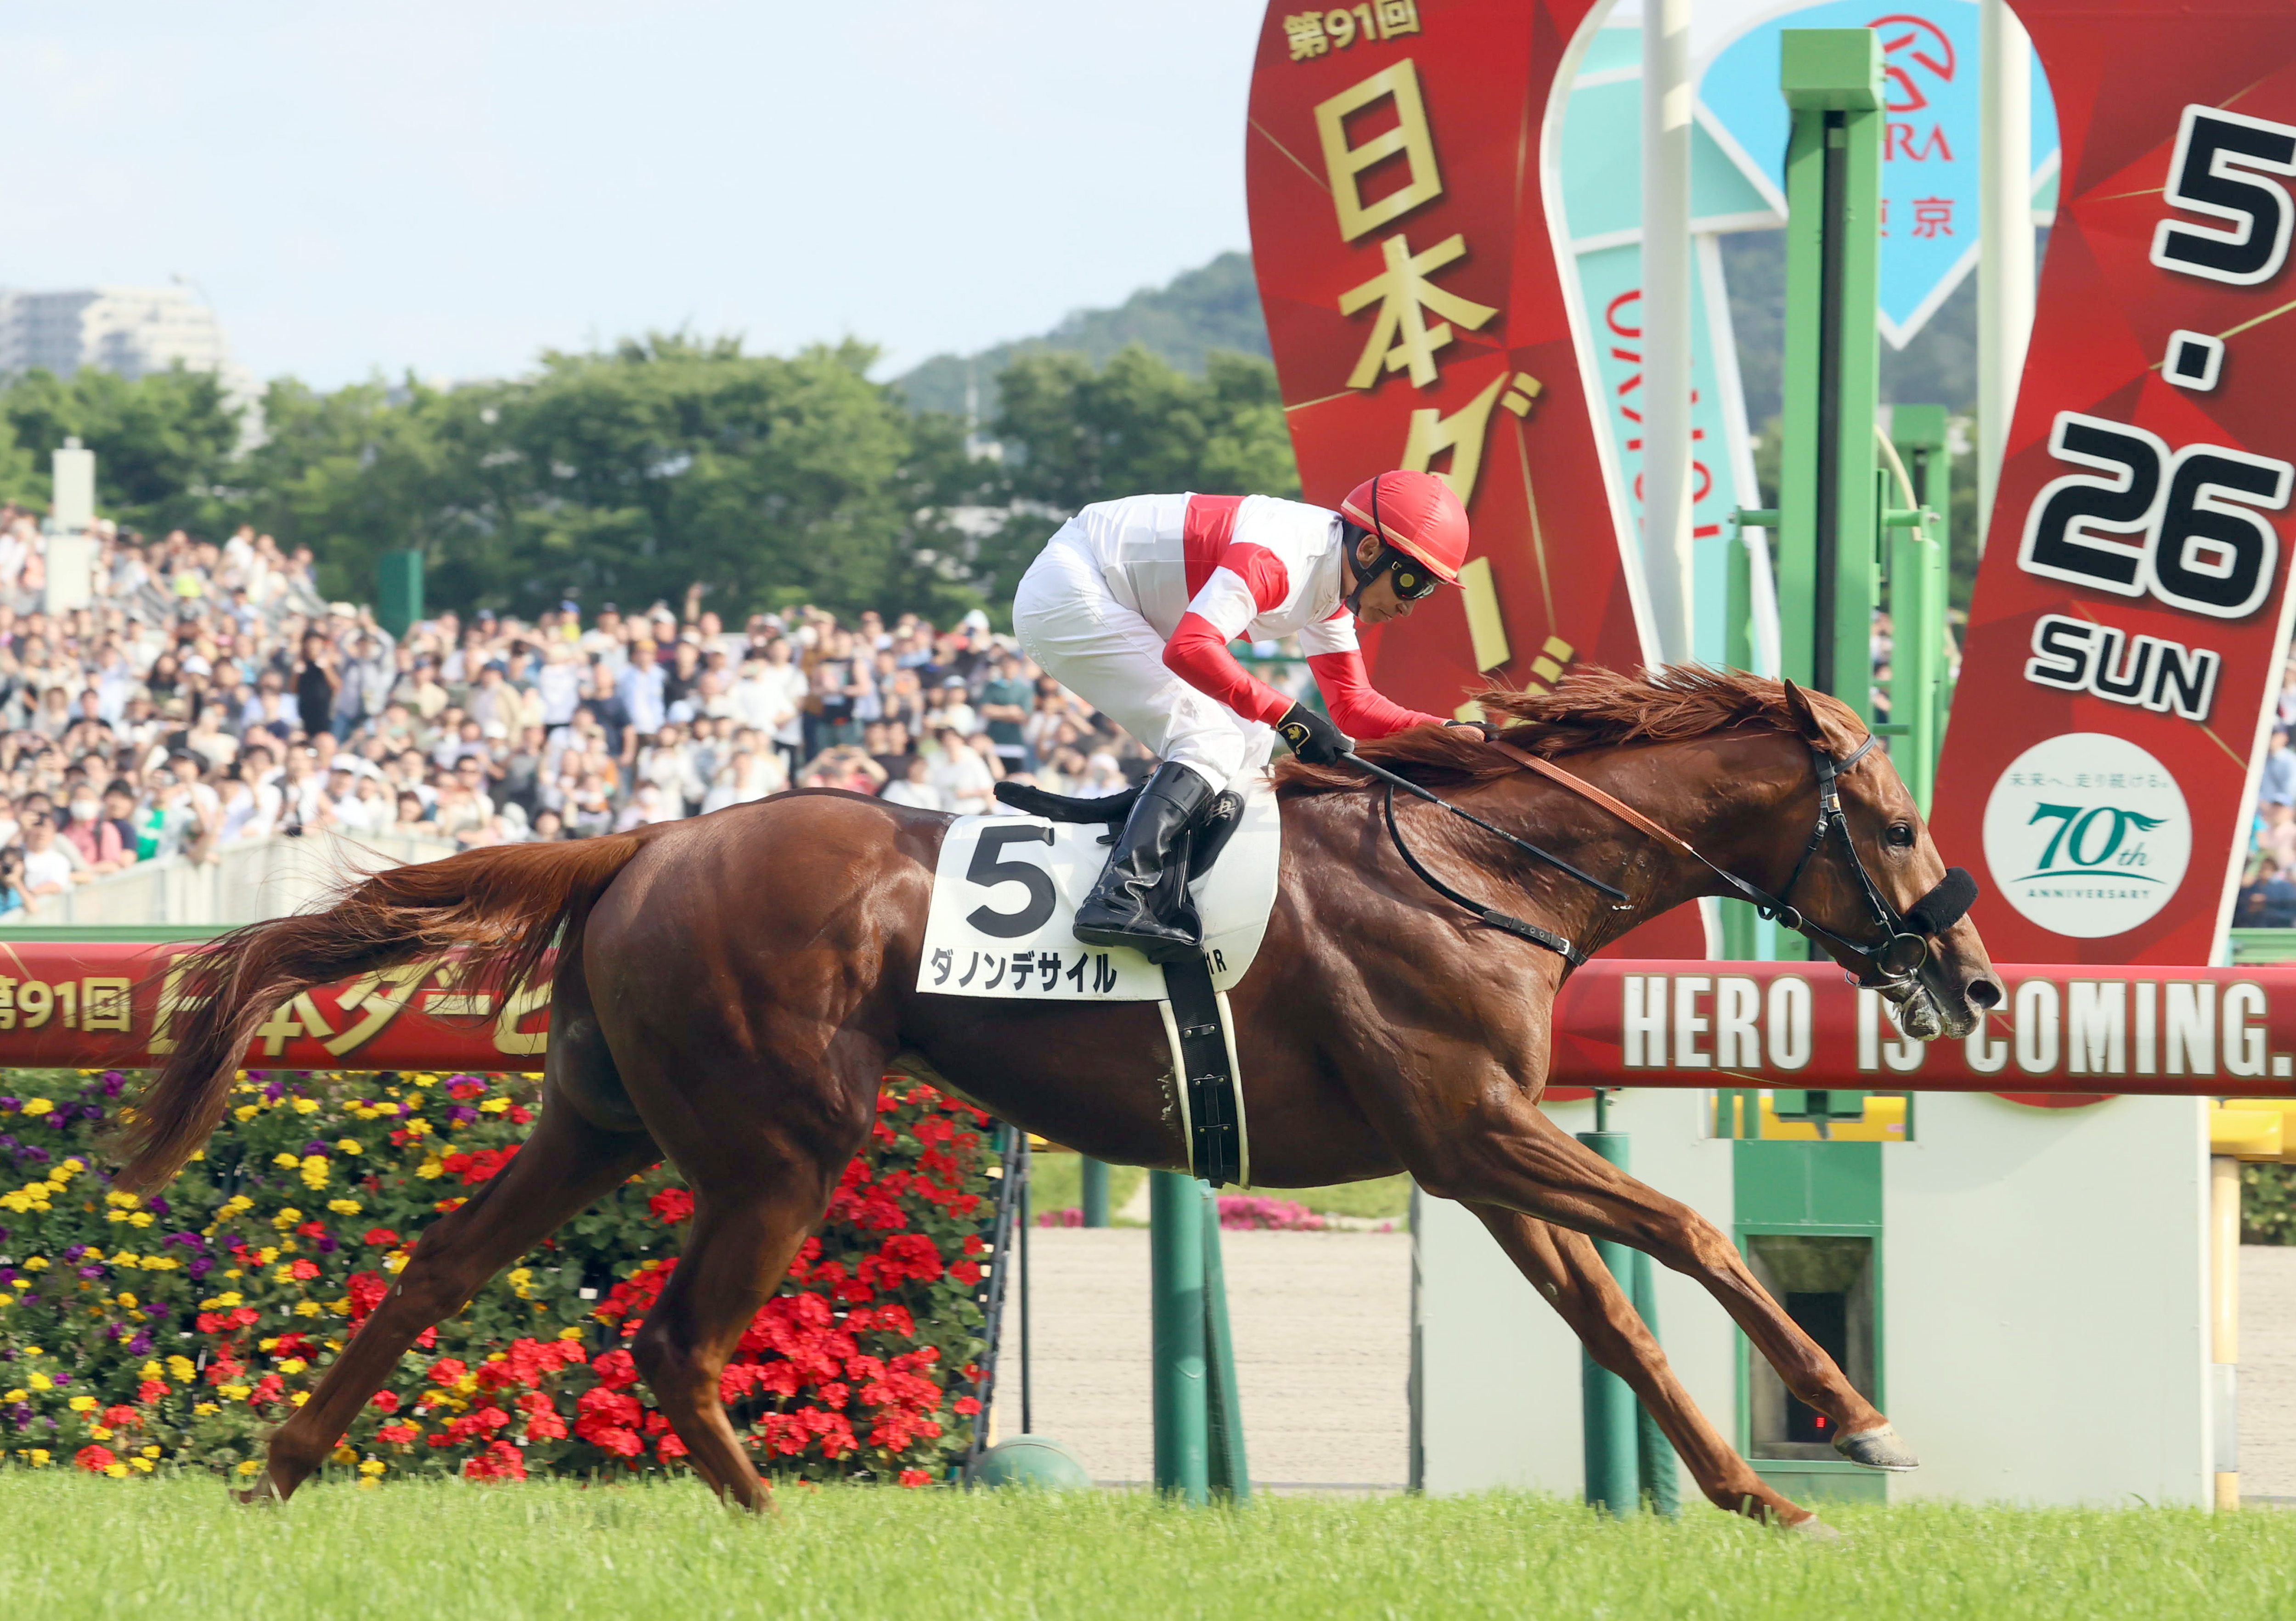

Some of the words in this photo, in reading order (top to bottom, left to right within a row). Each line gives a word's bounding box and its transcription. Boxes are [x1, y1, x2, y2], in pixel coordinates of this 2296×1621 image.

[1282, 0, 1421, 61] 第91回
[1884, 123, 1954, 161] RA
[1881, 197, 1955, 239] 京
[2017, 410, 2295, 619] 26
[2024, 614, 2221, 721] SUN
[966, 825, 1056, 938] 5
[2026, 888, 2150, 898] ANNIVERSARY
[931, 948, 1117, 993] ダノンデサイル
[1623, 976, 1811, 1070] HERO
